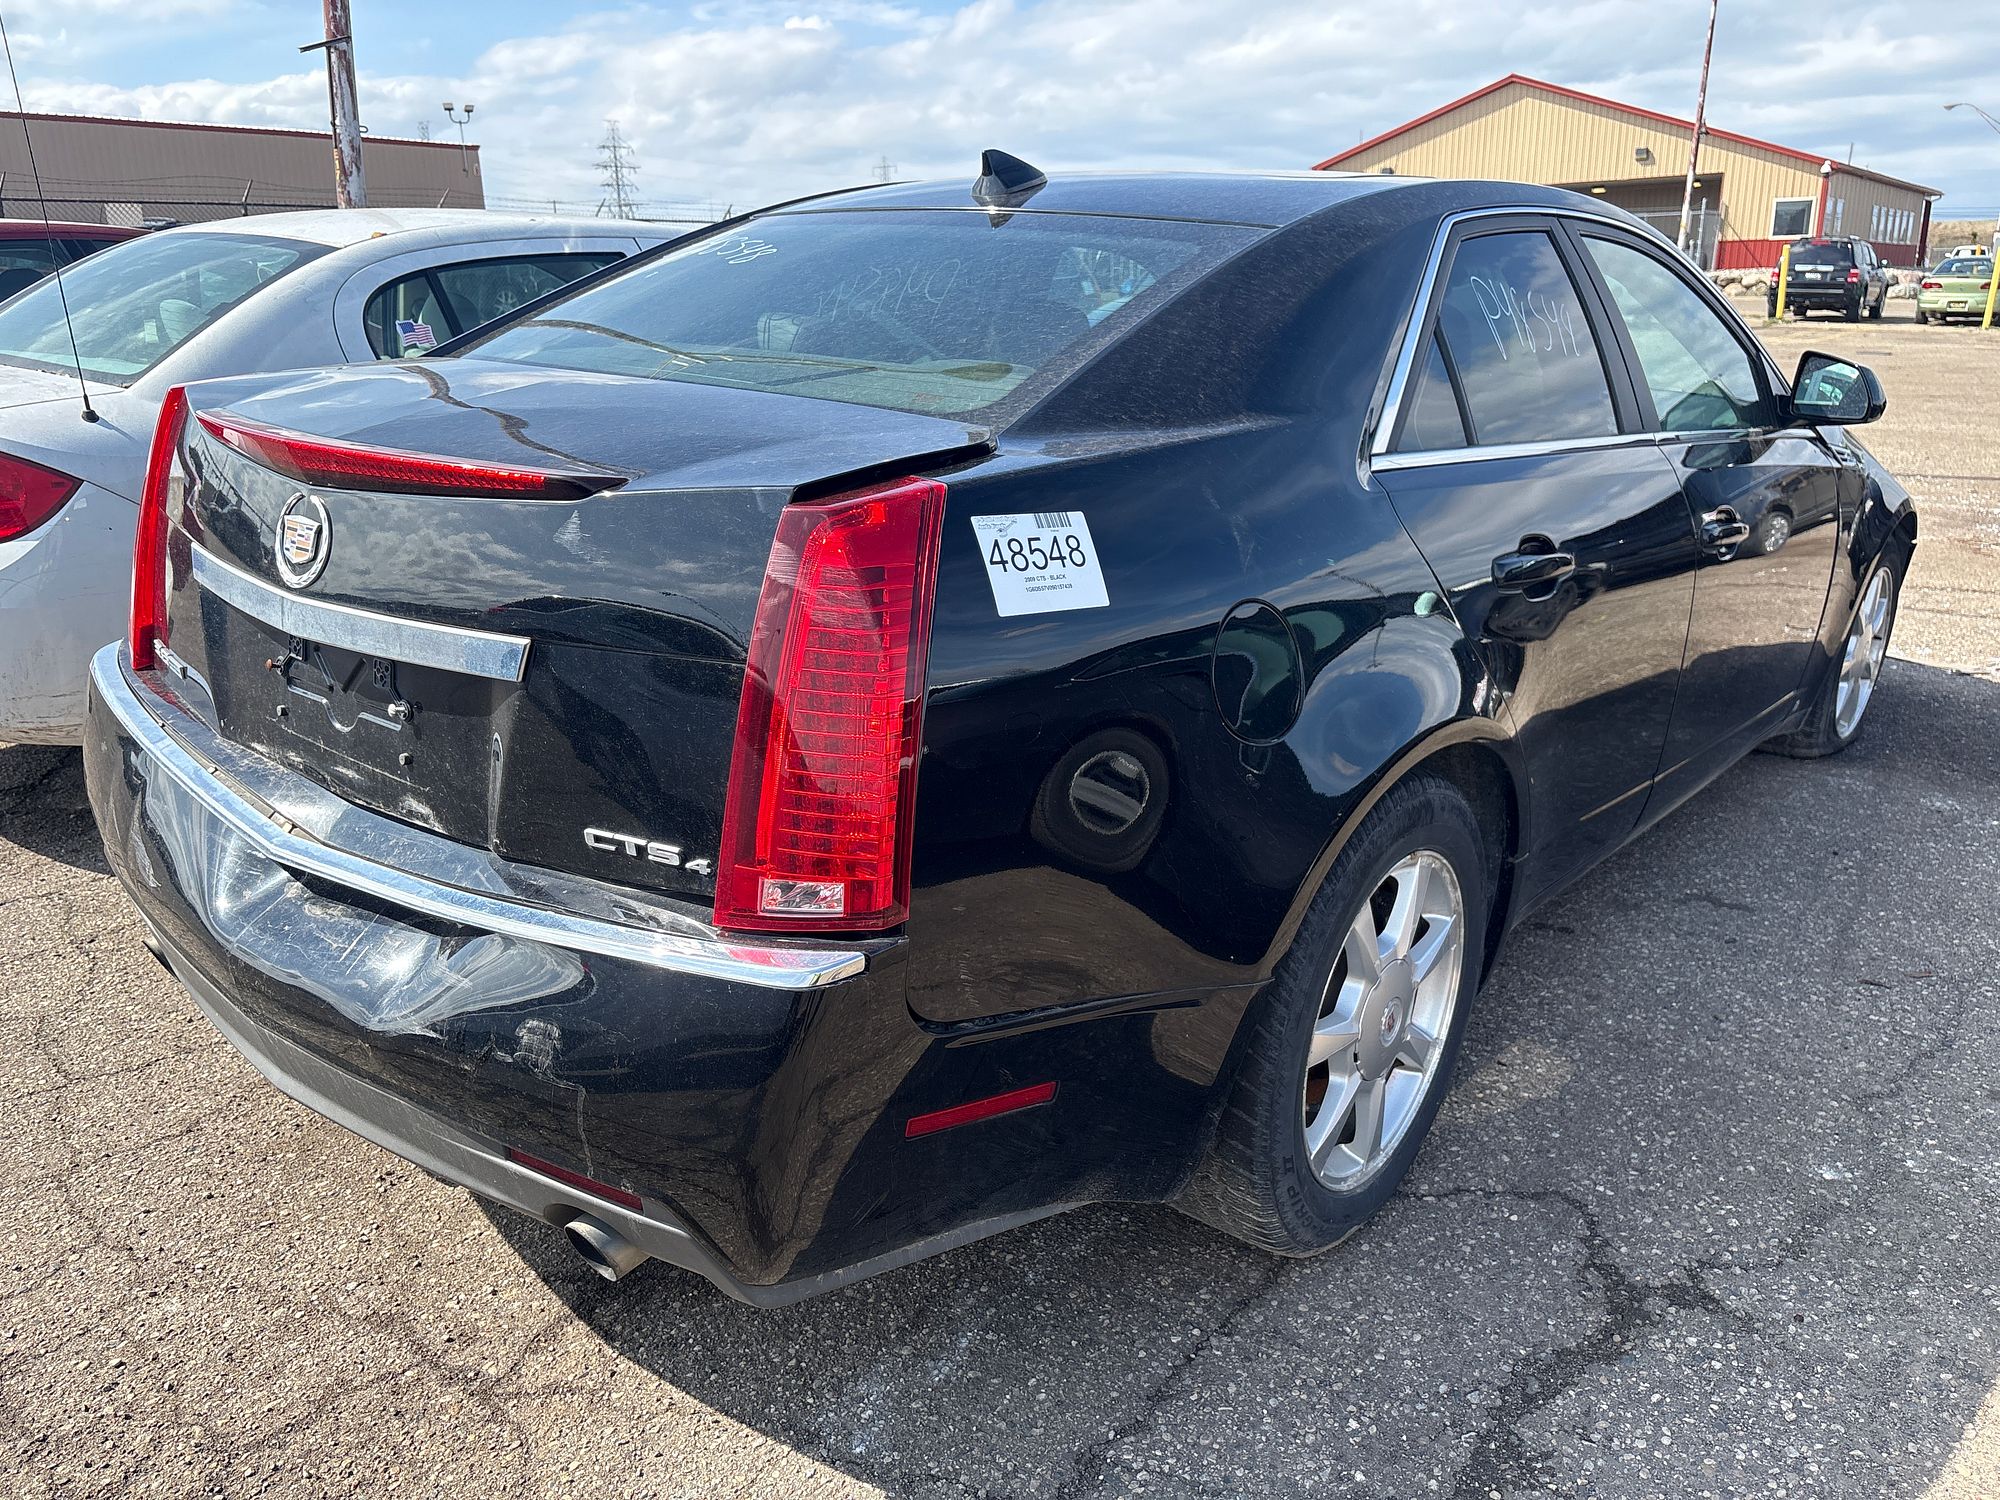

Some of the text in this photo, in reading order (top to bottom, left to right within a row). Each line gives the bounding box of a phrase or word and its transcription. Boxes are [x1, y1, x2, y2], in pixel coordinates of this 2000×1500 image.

[989, 535, 1086, 573] 48548
[1049, 573, 1067, 581] BLACK
[583, 828, 712, 875] CTS 4
